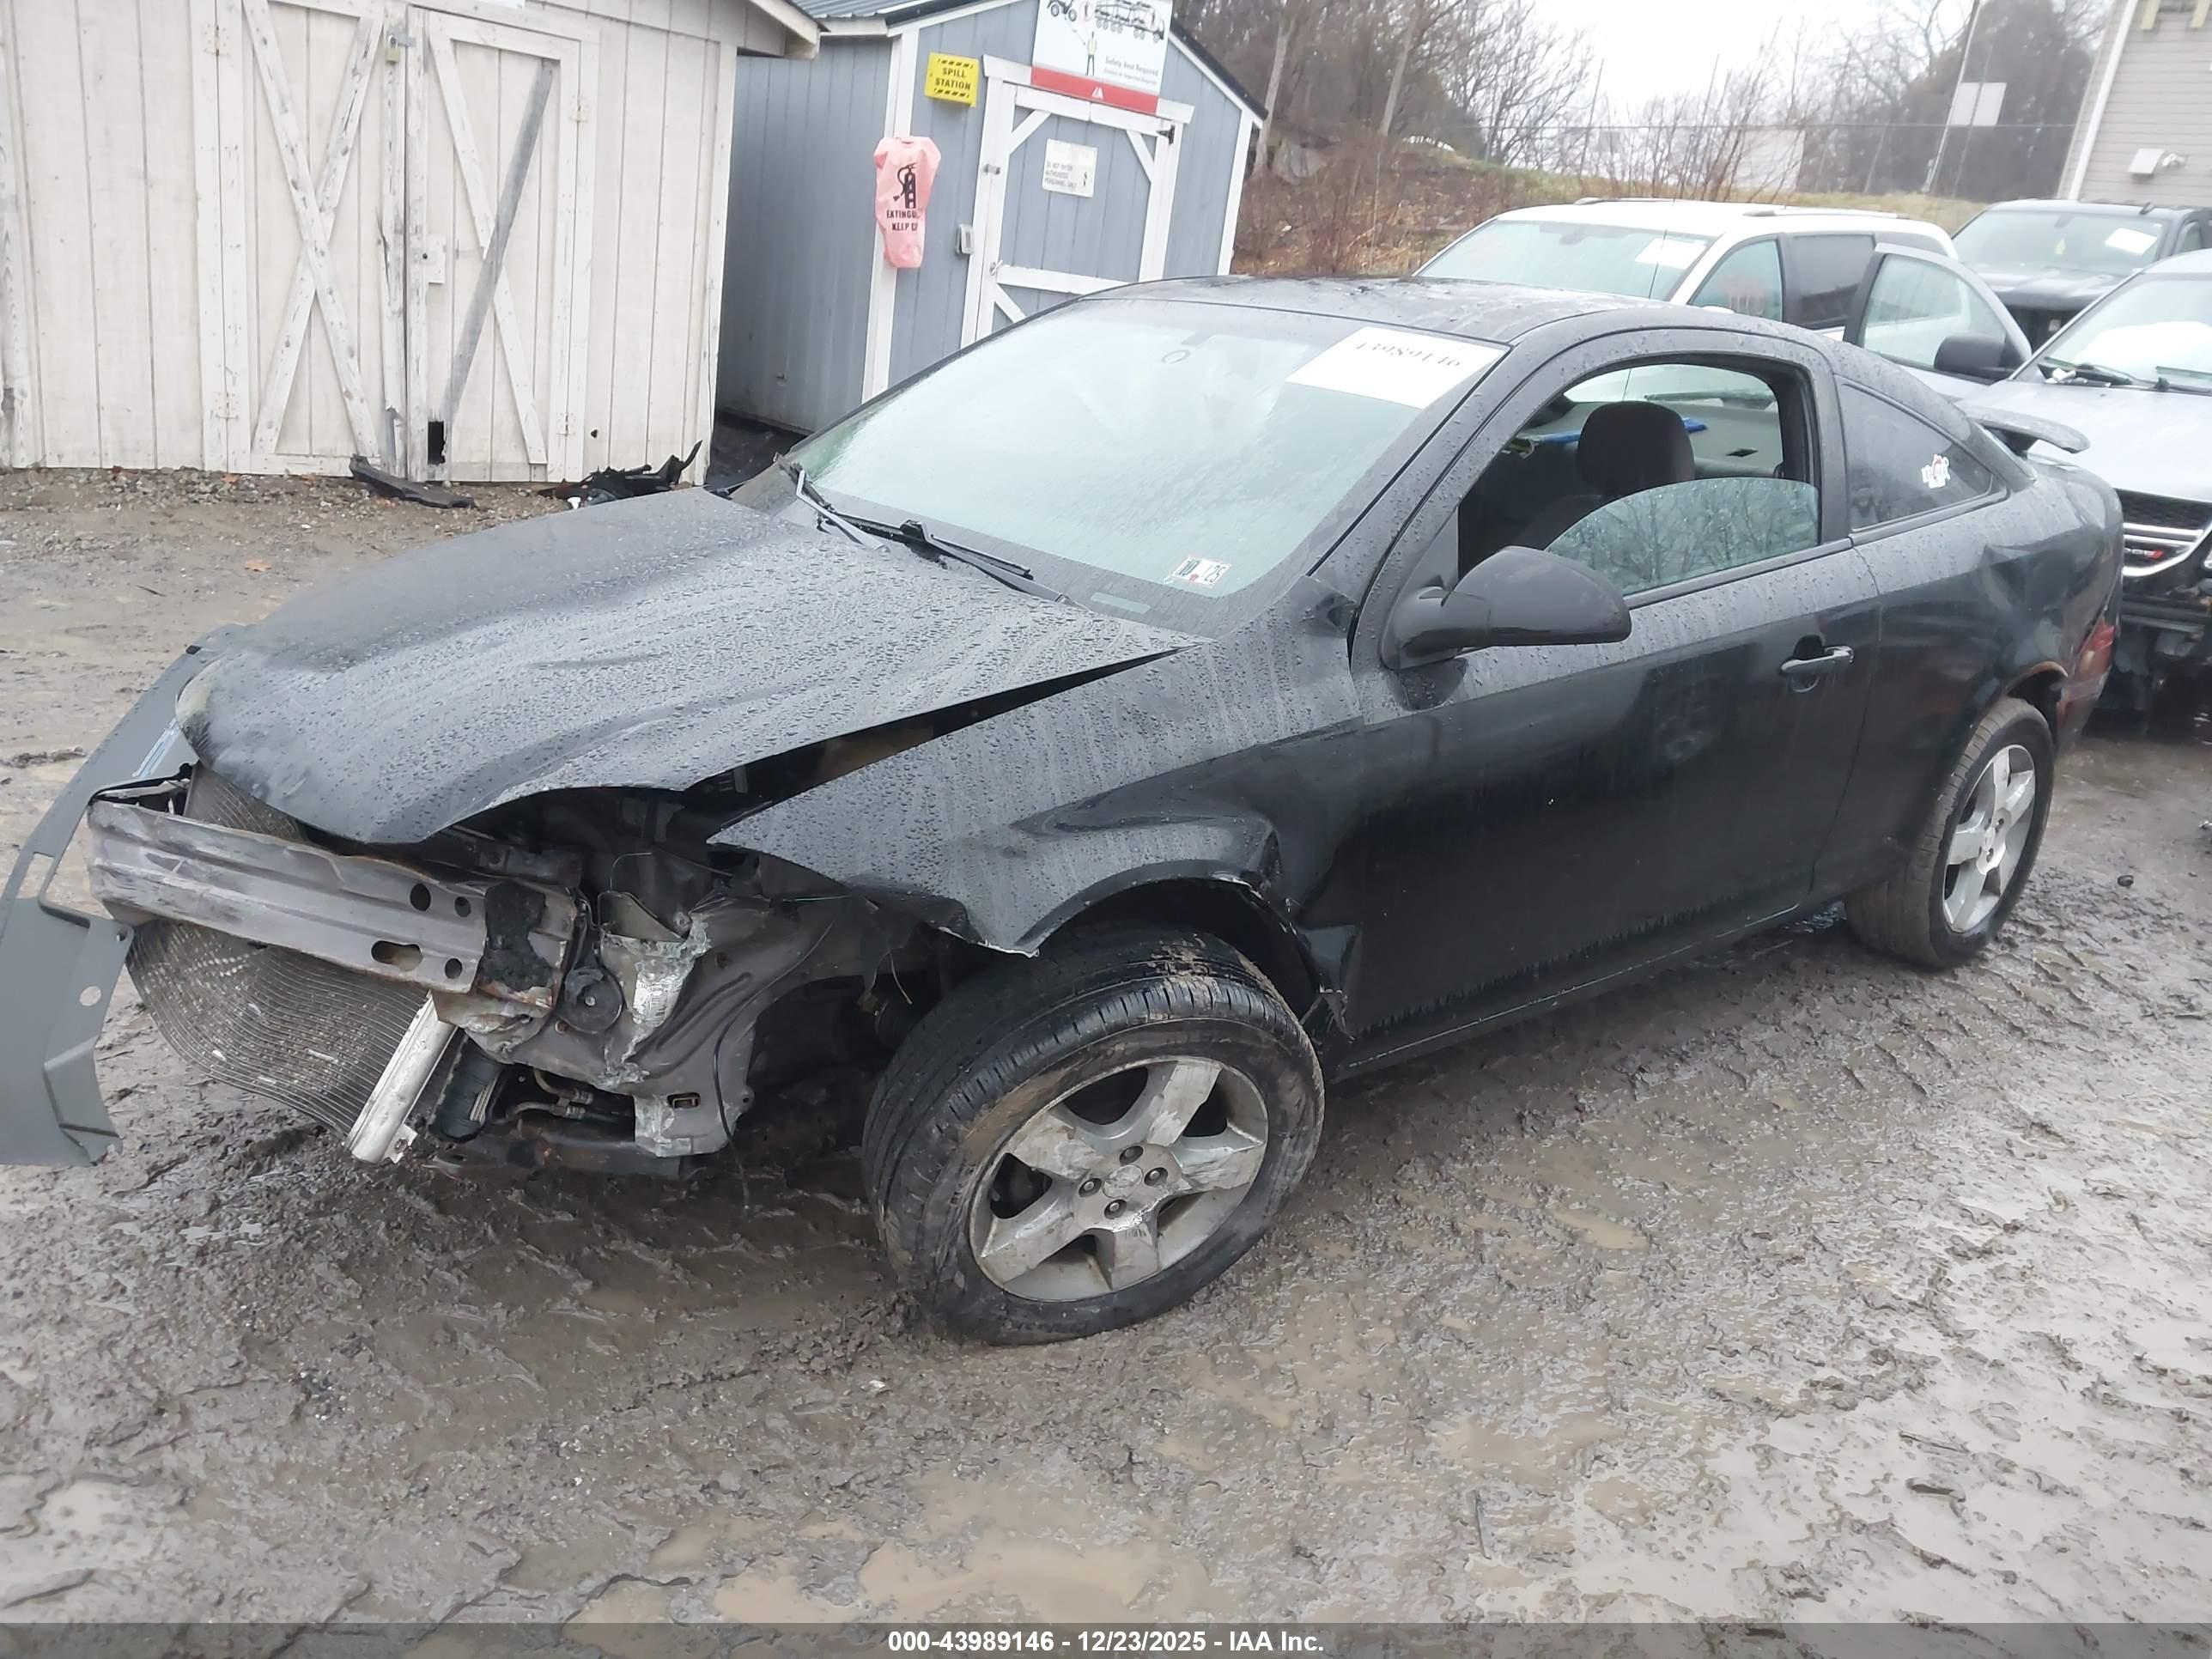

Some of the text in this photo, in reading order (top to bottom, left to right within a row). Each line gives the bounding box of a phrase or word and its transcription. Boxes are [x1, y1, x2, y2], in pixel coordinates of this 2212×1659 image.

[943, 68, 967, 78] SPILL
[935, 77, 971, 90] STATION
[892, 222, 909, 231] KEEP
[1204, 565, 1226, 583] 25
